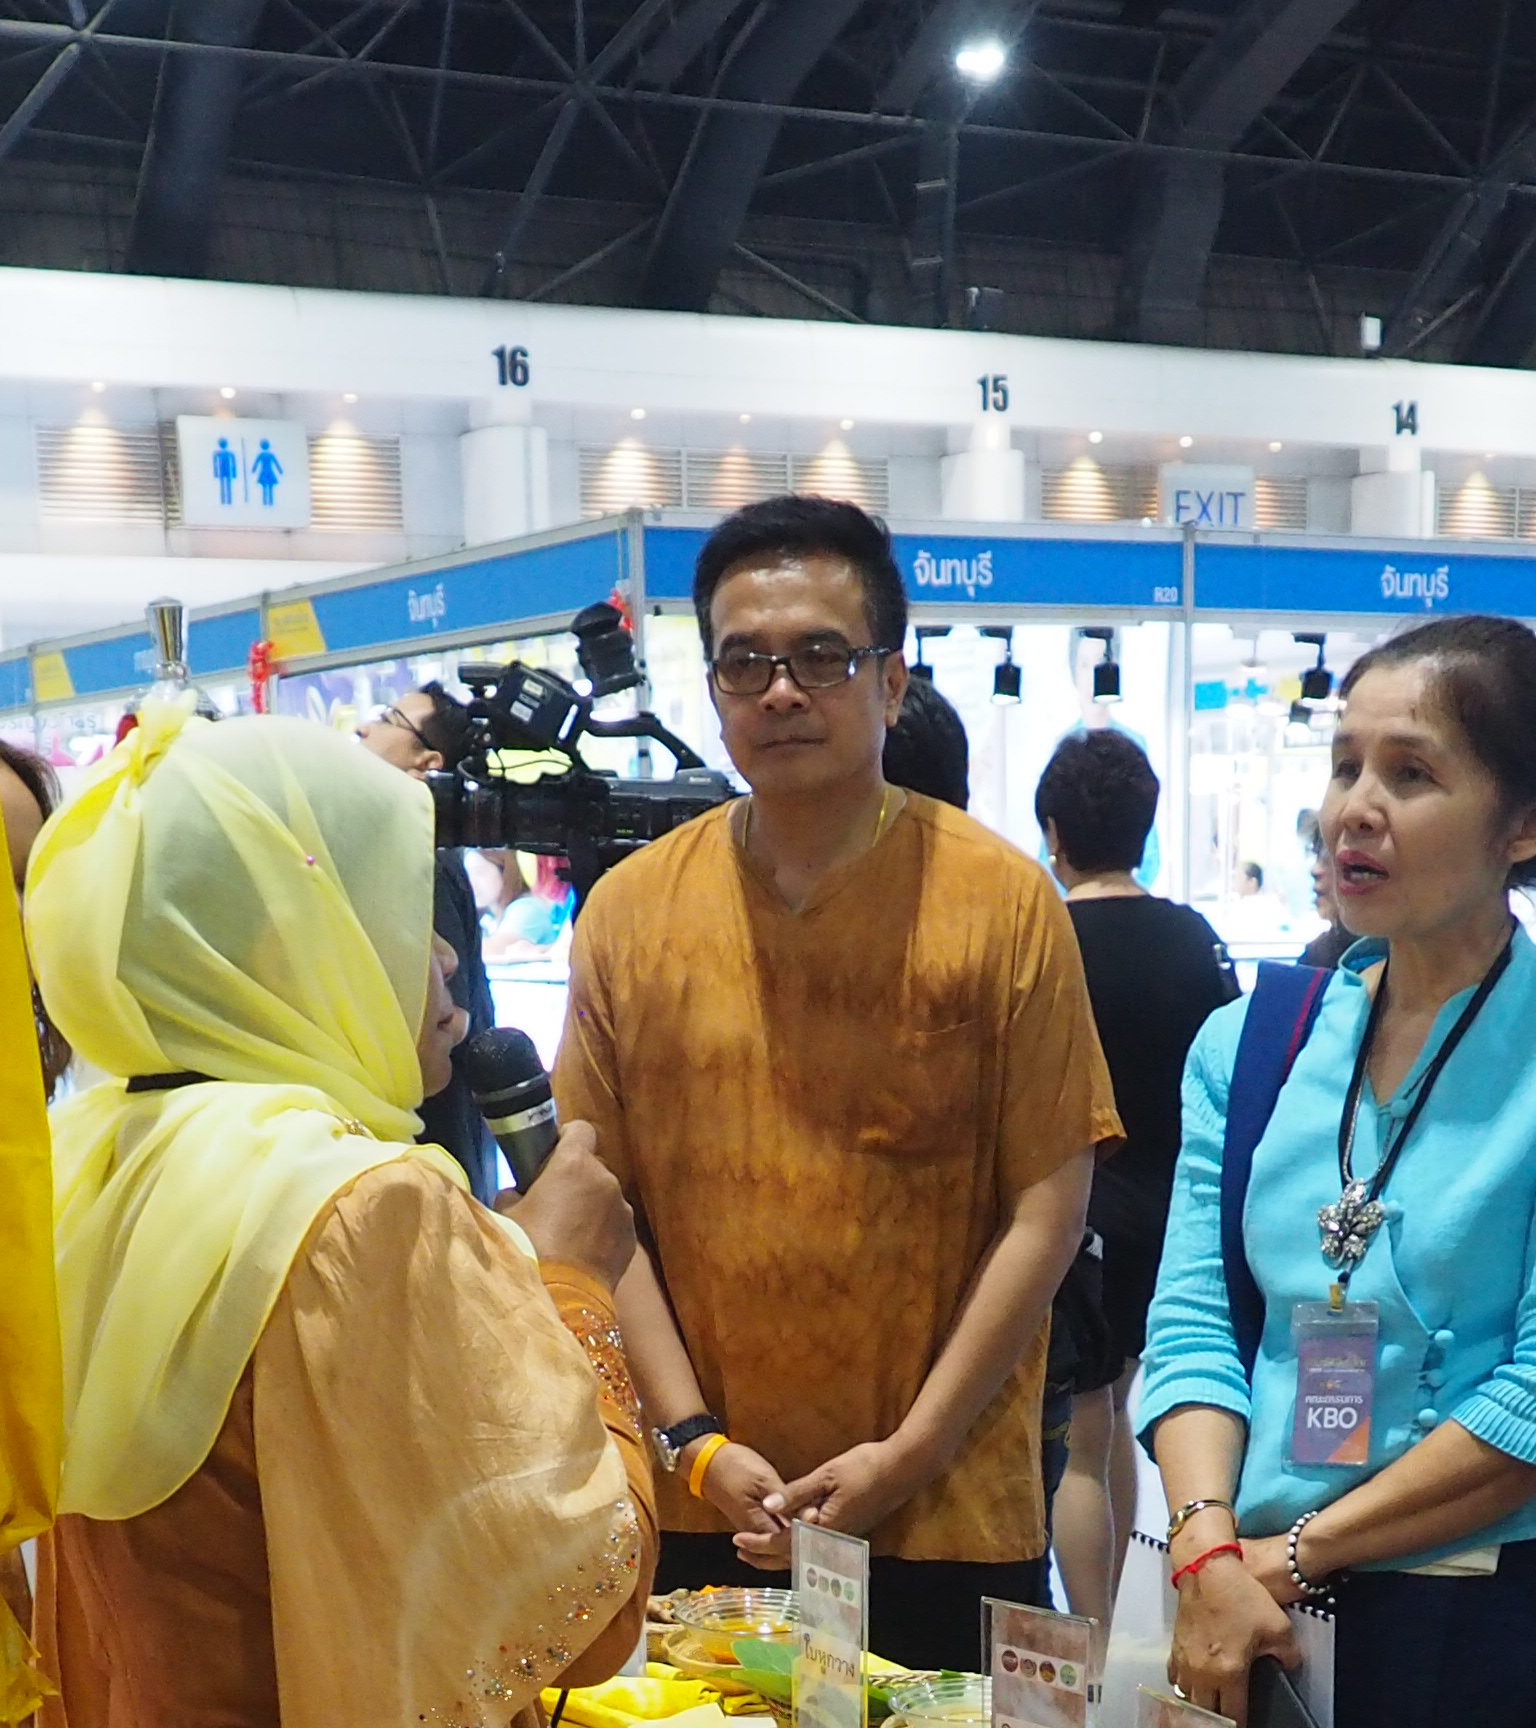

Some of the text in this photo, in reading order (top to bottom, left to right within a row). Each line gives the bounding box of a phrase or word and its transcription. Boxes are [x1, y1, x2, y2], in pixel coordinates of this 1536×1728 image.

[492, 344, 530, 387] 16
[977, 374, 1009, 412] 15
[1393, 401, 1418, 435] 14
[1175, 489, 1246, 525] EXIT
[914, 550, 993, 597] จันทบุรี
[1381, 564, 1449, 608] จันทบุรี
[1307, 1406, 1358, 1430] KBO
